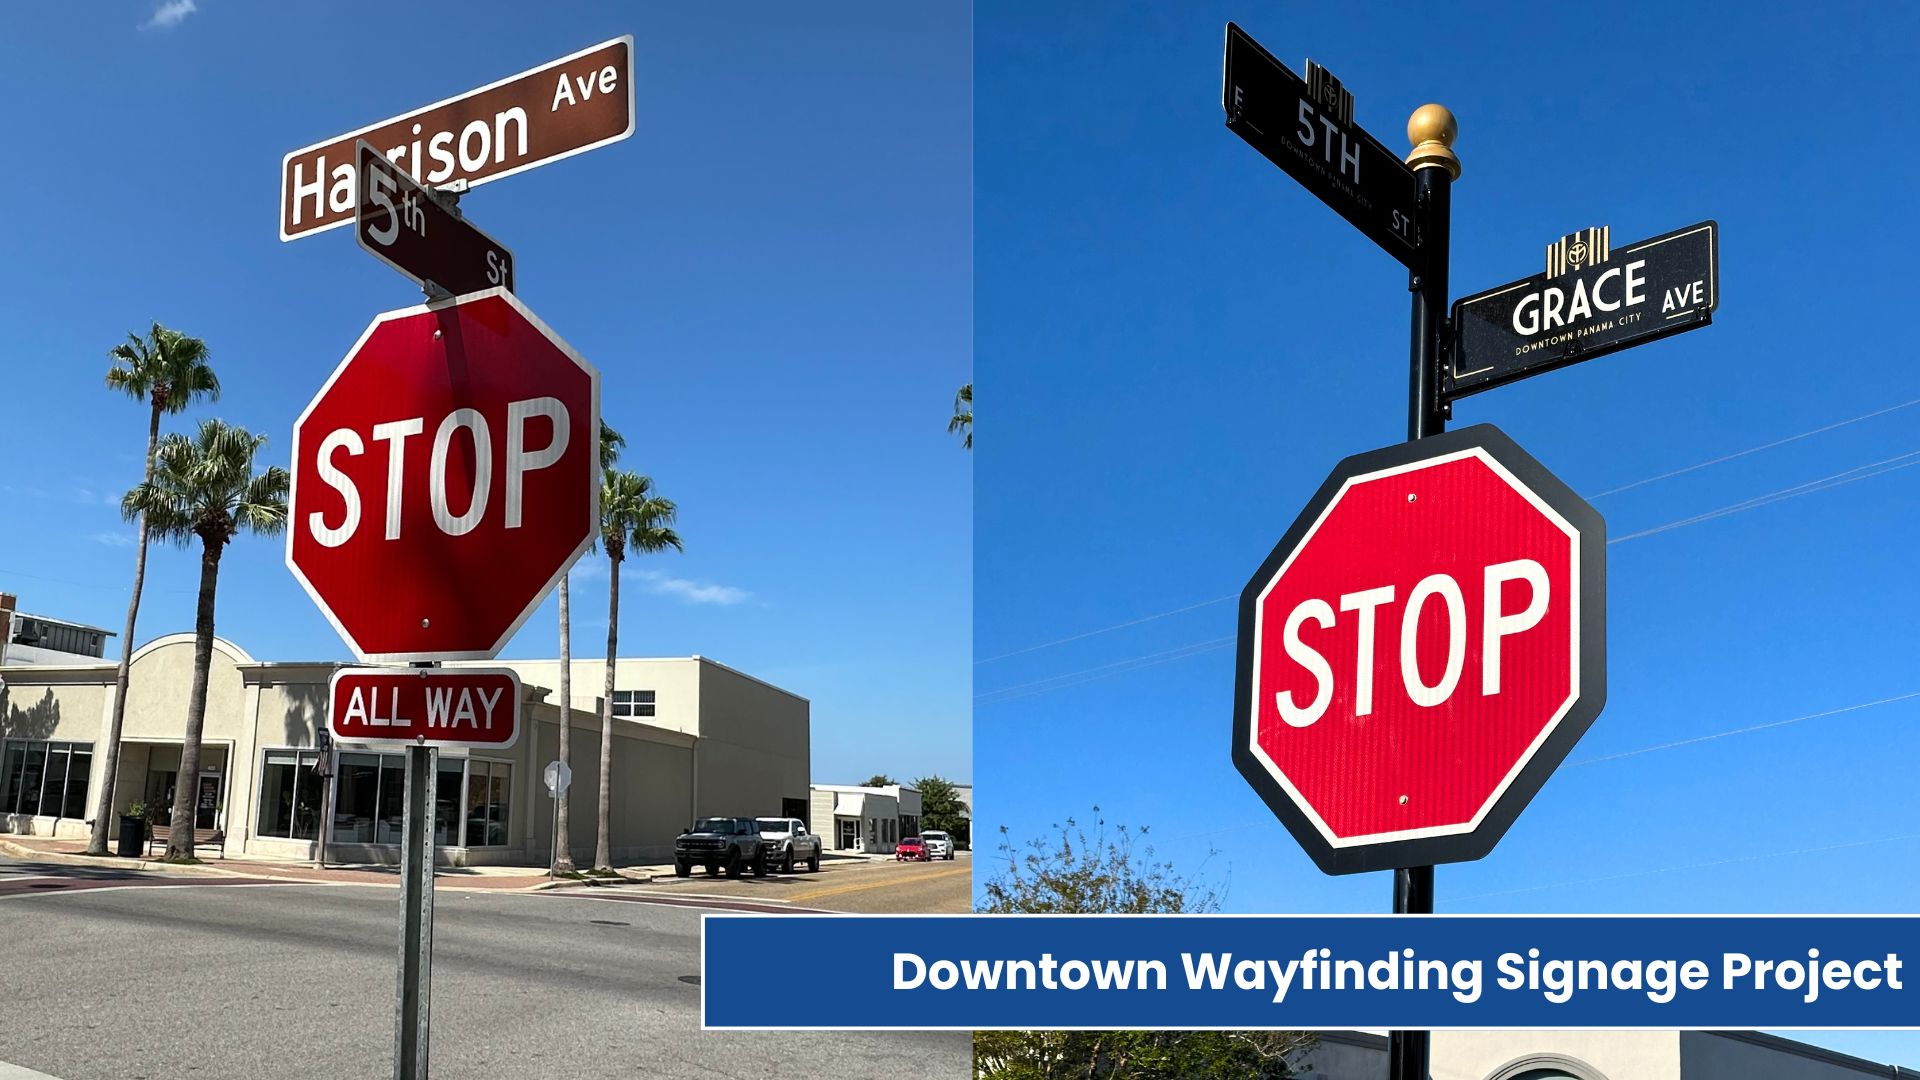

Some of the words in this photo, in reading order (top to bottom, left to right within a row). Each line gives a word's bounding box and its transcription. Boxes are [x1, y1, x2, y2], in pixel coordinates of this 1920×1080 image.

[551, 64, 618, 112] Ave
[1296, 97, 1361, 185] 5TH
[1392, 208, 1410, 237] ST
[367, 162, 426, 247] 5th
[486, 250, 508, 287] St
[1512, 259, 1646, 336] GRACE
[1661, 280, 1704, 314] AVE
[1515, 331, 1574, 356] DOWNTOWN
[1577, 321, 1614, 338] PANAMA
[1619, 312, 1642, 327] CITY
[308, 396, 571, 548] STOP
[1275, 558, 1551, 728] STOP
[342, 686, 412, 727] ALL
[425, 686, 504, 730] WAY
